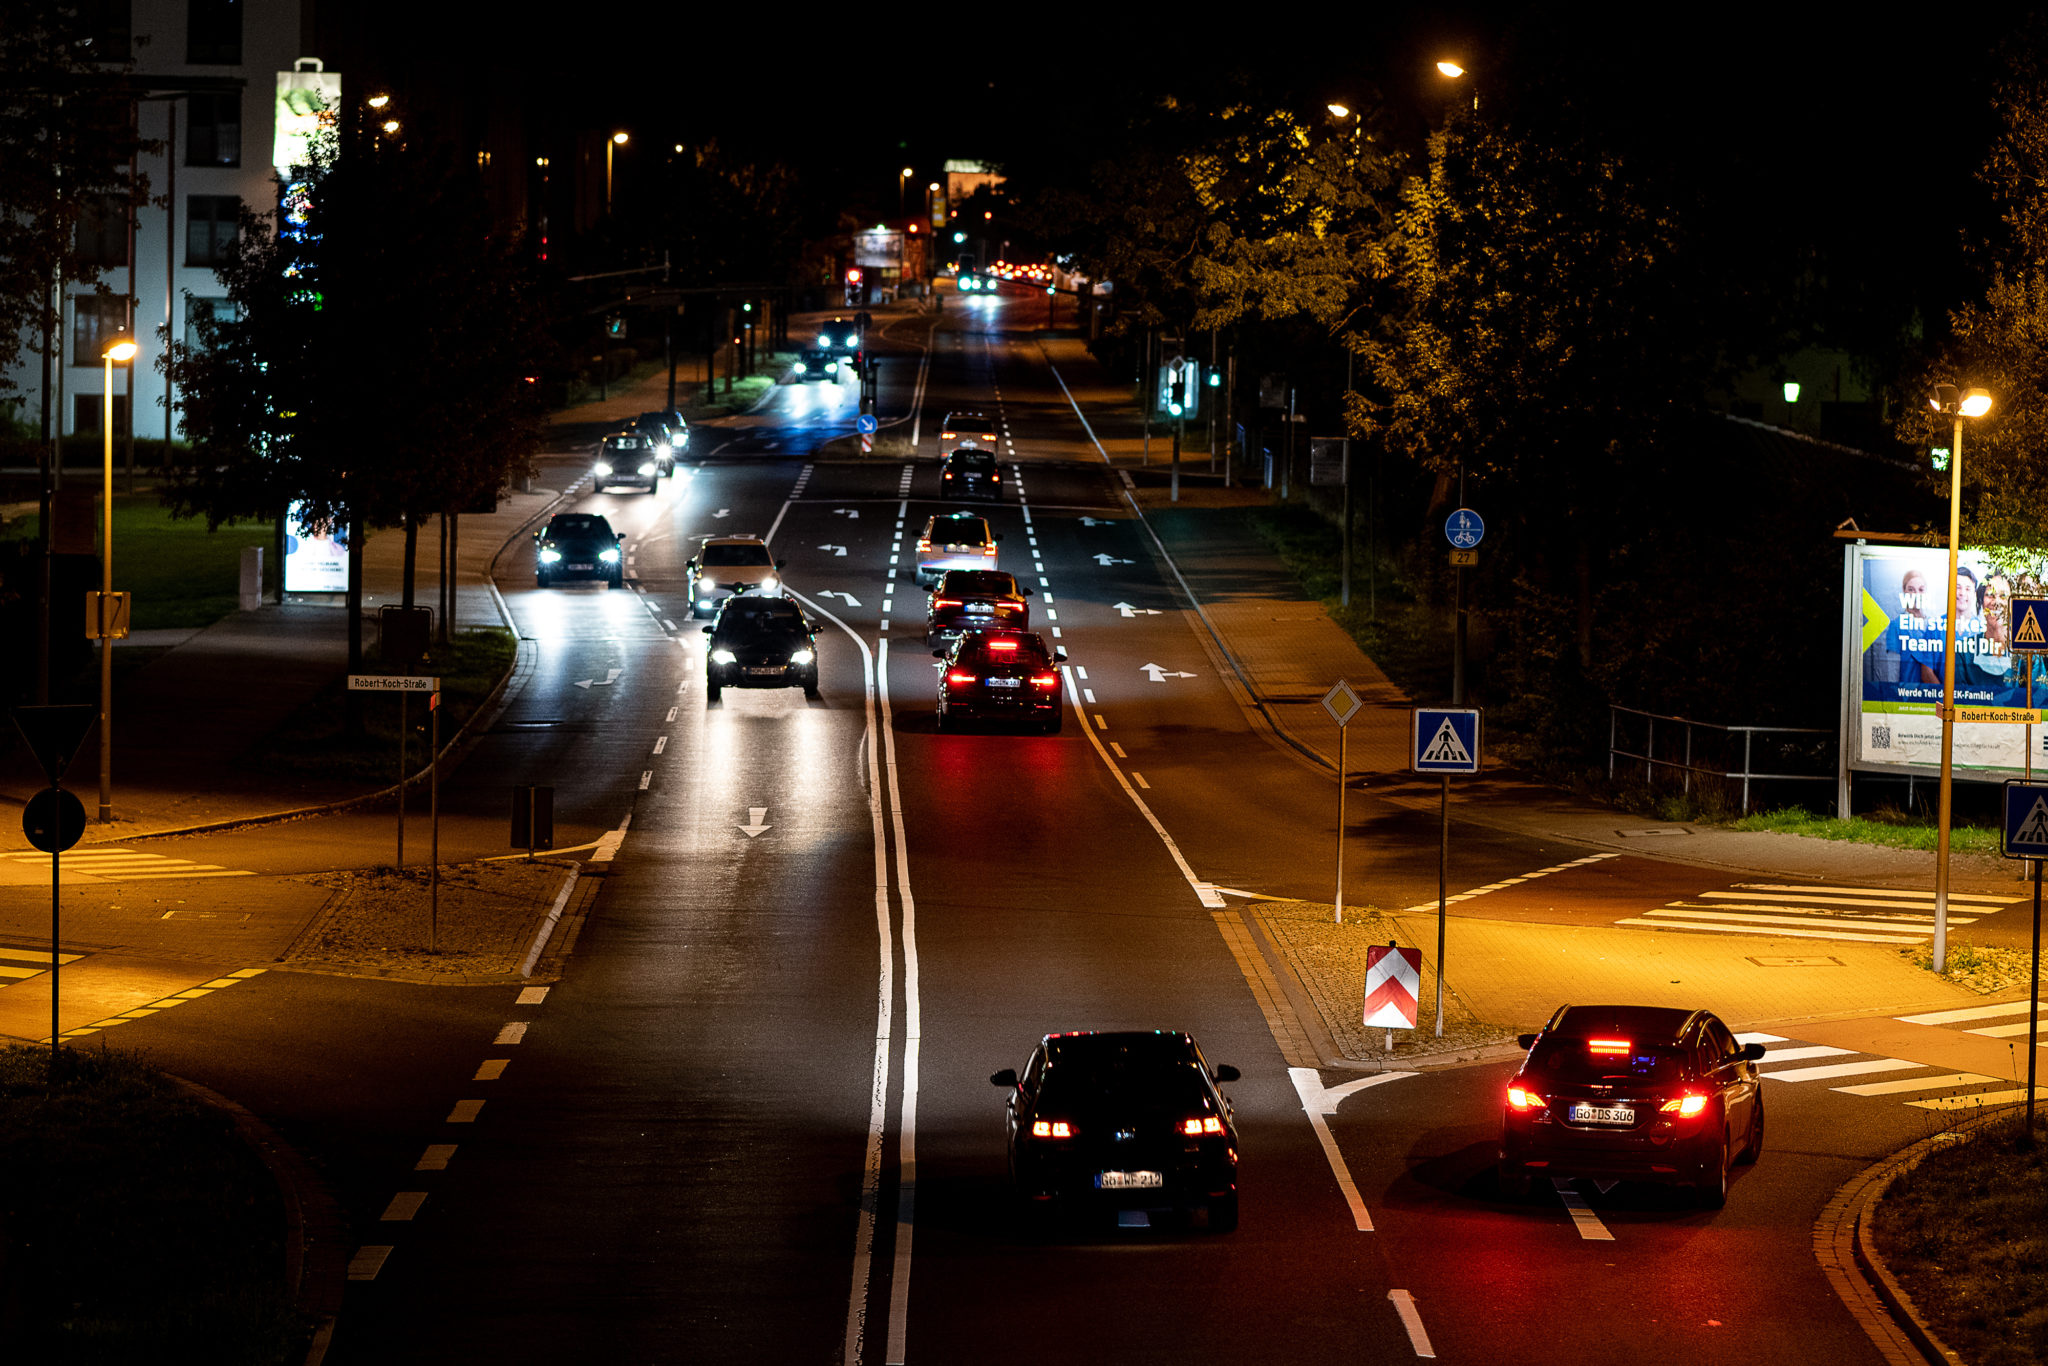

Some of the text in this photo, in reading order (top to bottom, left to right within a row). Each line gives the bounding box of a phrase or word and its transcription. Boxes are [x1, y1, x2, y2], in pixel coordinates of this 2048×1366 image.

[1899, 613, 1925, 632] Ein
[1898, 635, 1944, 653] Team
[354, 678, 427, 689] Robert-Koch-Straße
[1897, 688, 1922, 698] Werde
[1923, 688, 1937, 698] Teil
[1961, 711, 2035, 722] Robert-Koch-Straße
[1597, 1109, 1611, 1120] DS
[1612, 1110, 1633, 1121] 306
